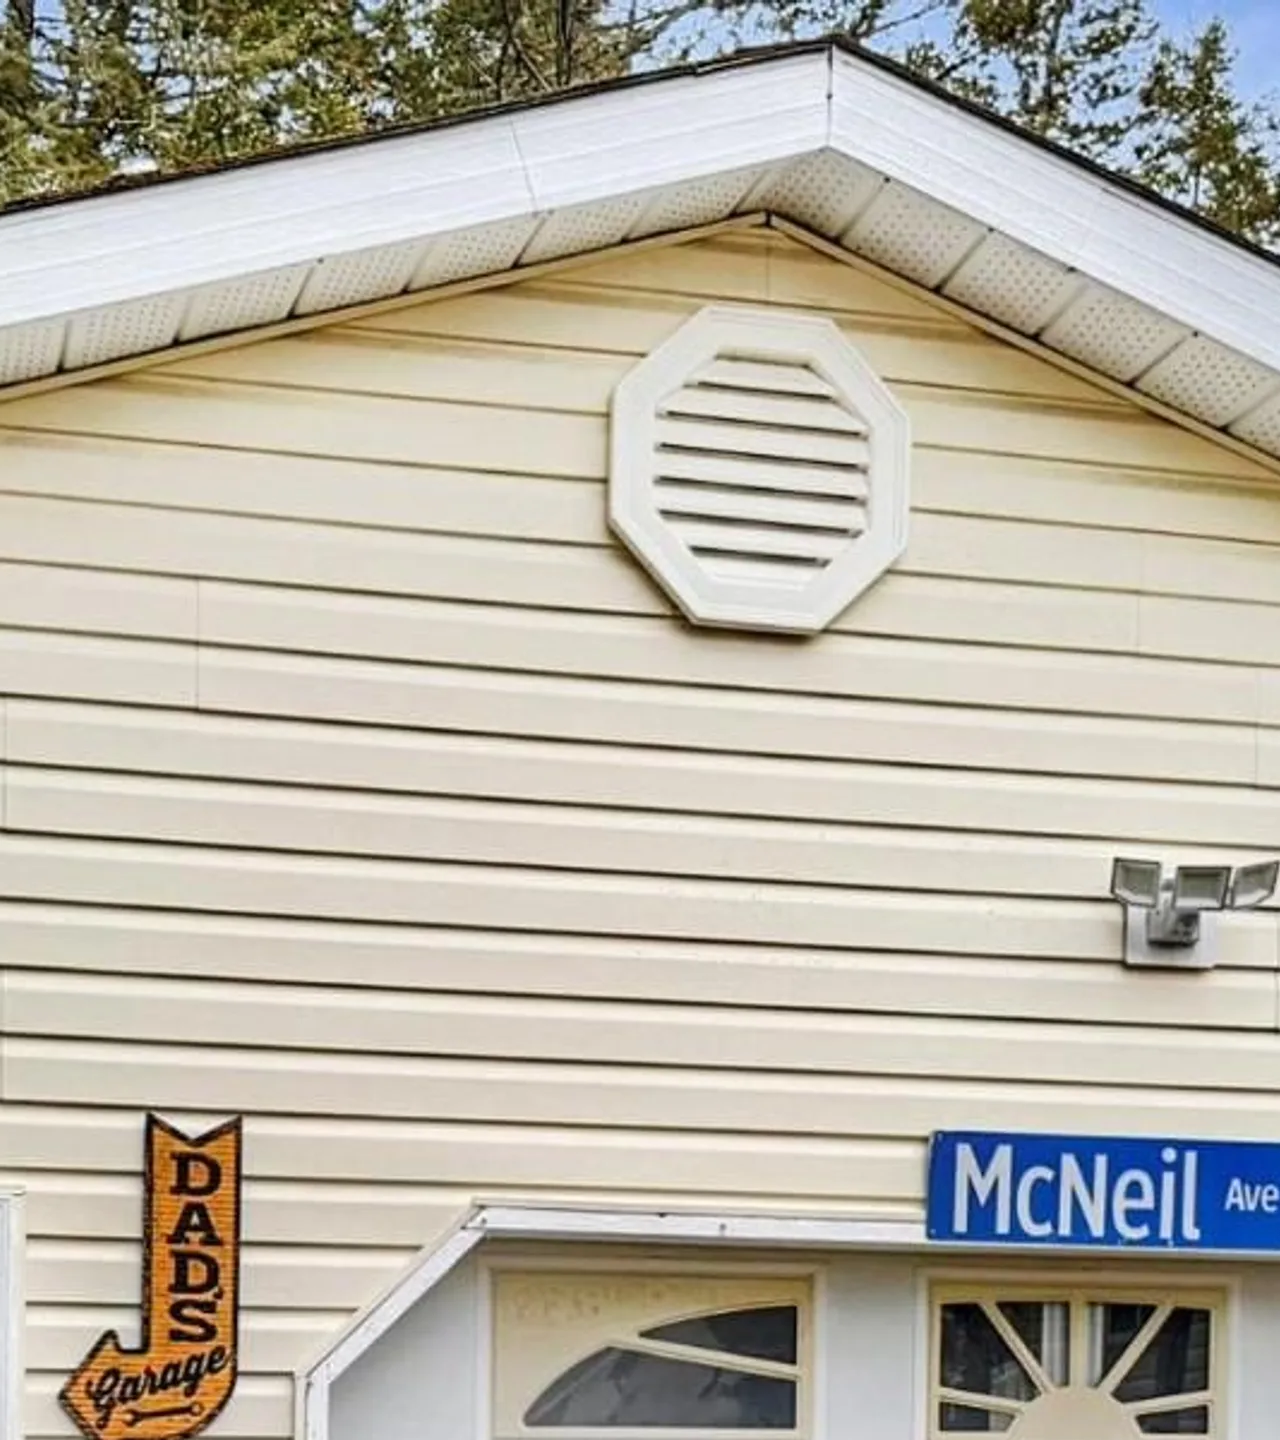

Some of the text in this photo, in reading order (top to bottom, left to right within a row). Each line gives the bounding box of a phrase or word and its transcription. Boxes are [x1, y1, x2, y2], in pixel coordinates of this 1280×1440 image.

[952, 1142, 1280, 1241] McNeil Ave
[86, 1345, 229, 1428] Garage
